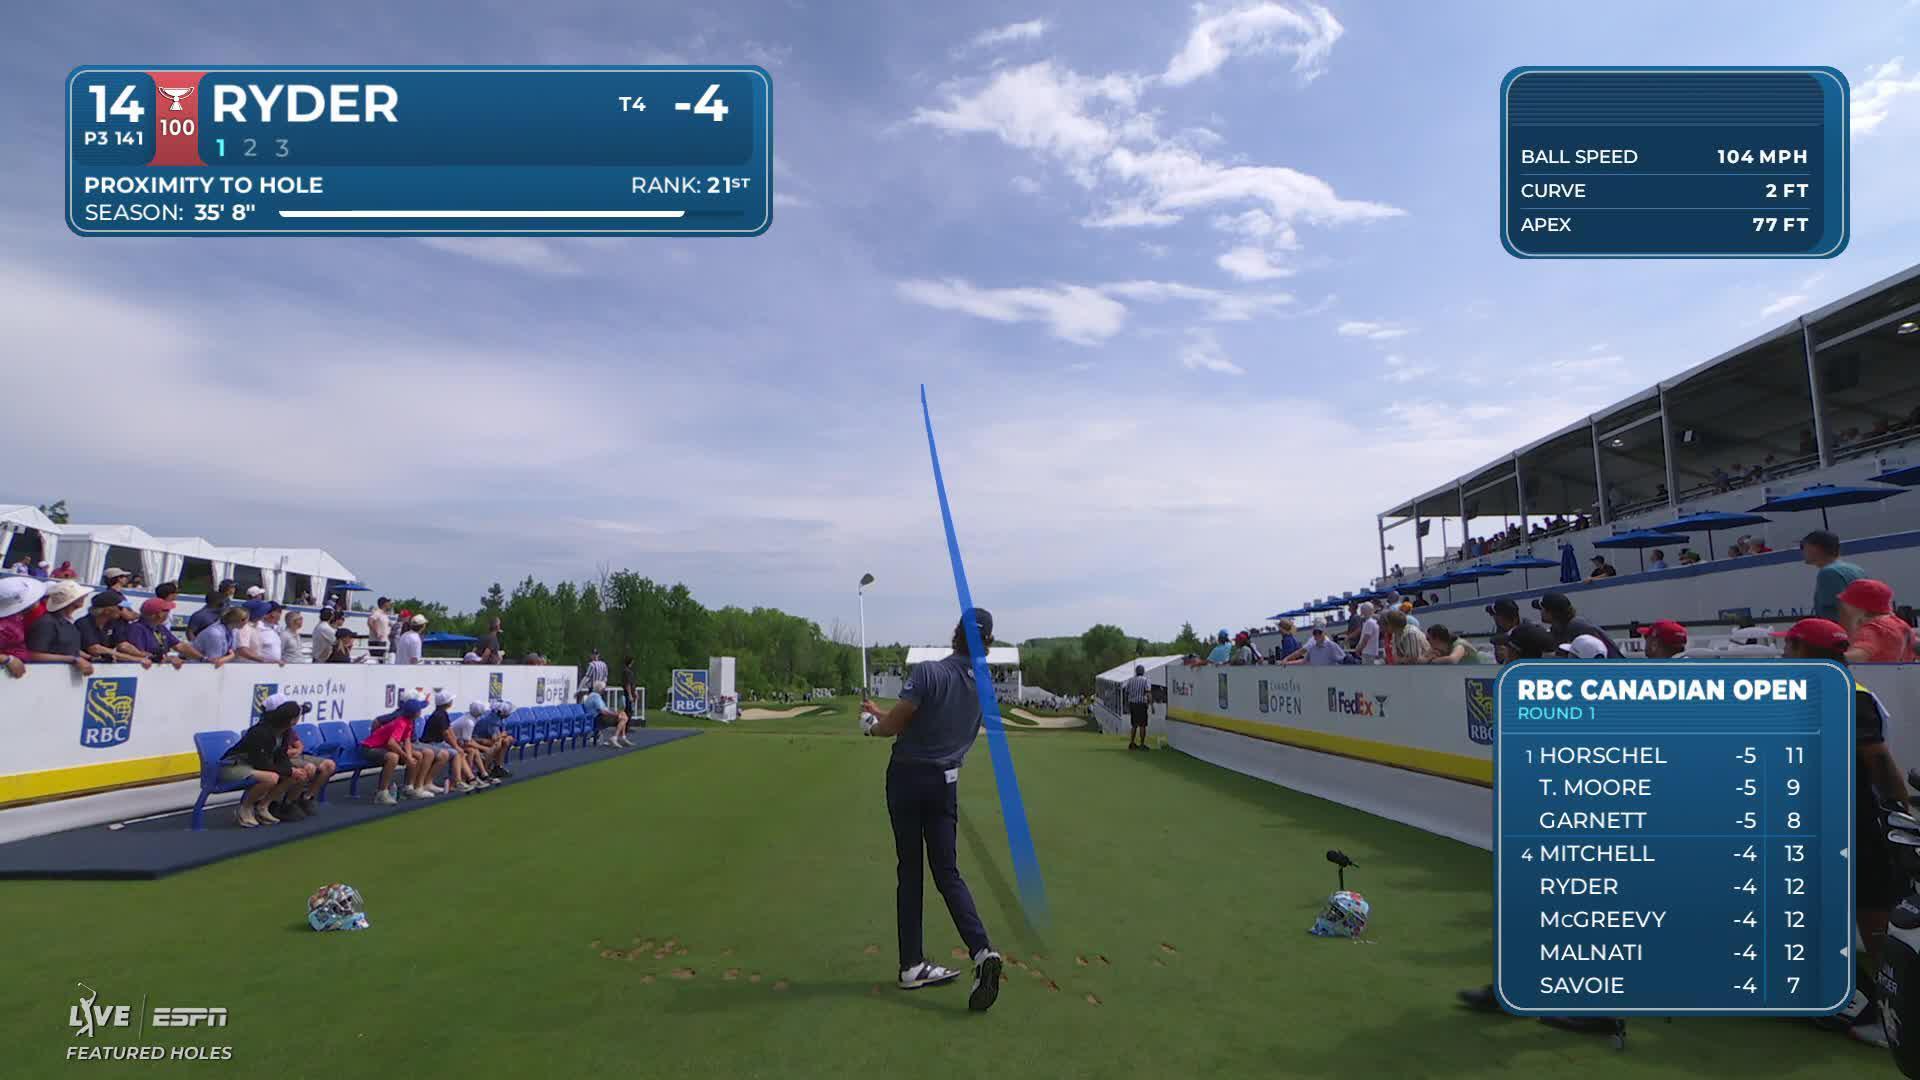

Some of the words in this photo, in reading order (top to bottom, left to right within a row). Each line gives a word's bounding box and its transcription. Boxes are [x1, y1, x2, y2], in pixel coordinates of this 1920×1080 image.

[283, 678, 346, 696] CANADIAN
[676, 700, 705, 710] RBC
[1270, 695, 1302, 714] OPEN
[1338, 691, 1374, 716] FedEx
[86, 726, 129, 743] RBC
